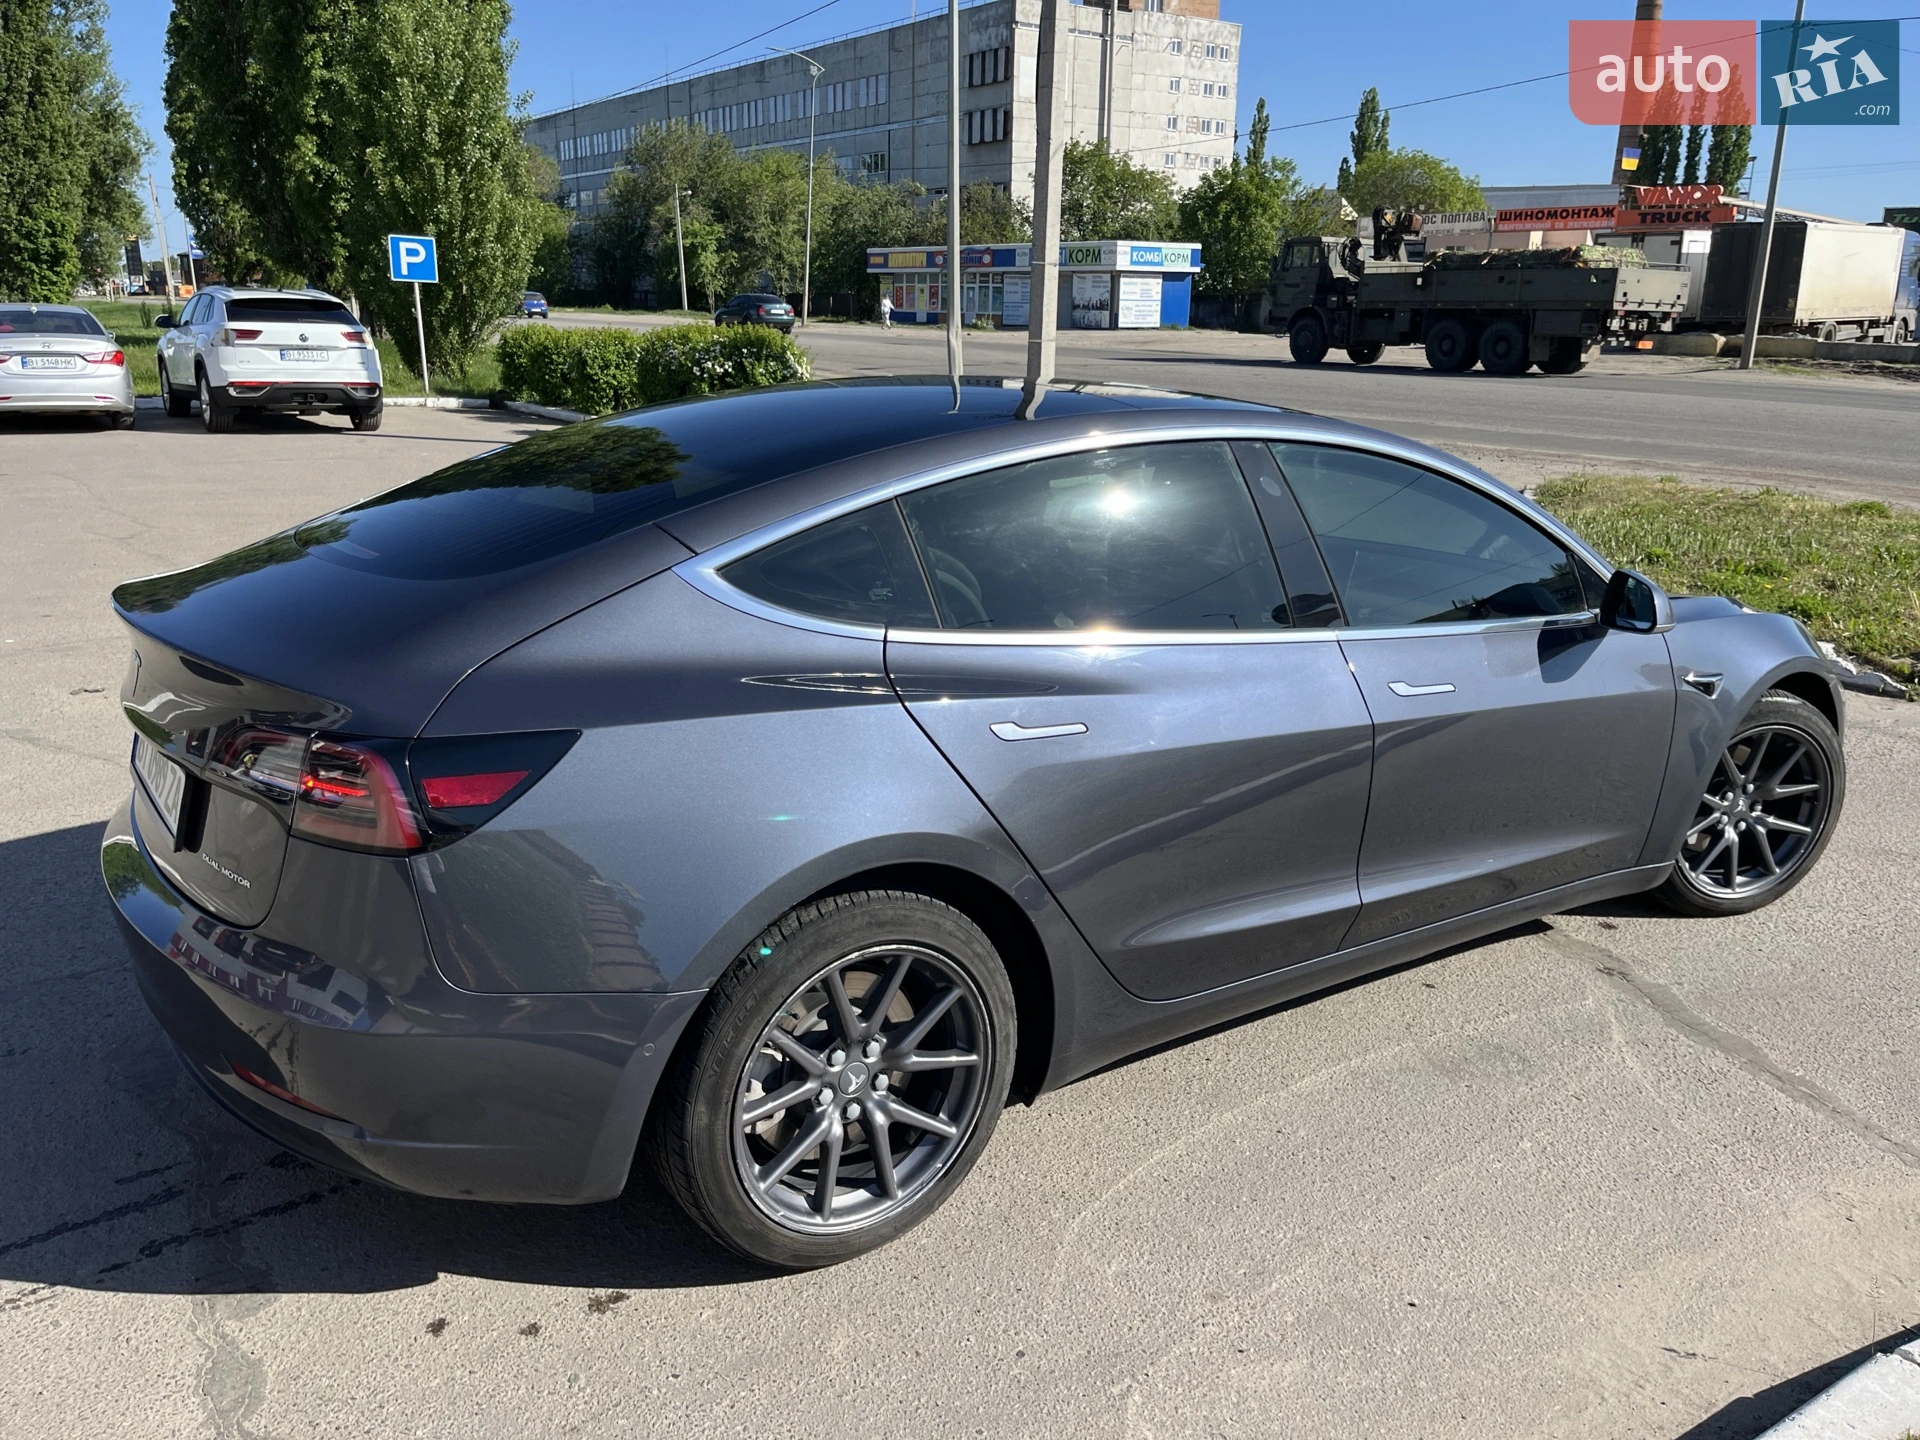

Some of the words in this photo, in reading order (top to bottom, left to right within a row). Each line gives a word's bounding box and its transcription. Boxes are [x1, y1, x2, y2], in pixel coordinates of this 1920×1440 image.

[1440, 212, 1485, 225] ПОЛТАВА
[1499, 207, 1616, 222] ШИНОМОНТАЖ
[1638, 210, 1711, 224] TRUCK
[1893, 213, 1920, 224] Tu
[399, 241, 427, 276] P
[1067, 248, 1101, 264] КОРМ
[1132, 251, 1162, 263] КОМБІ
[1164, 252, 1190, 263] КОРМ
[202, 853, 220, 871] DUAL
[222, 867, 251, 889] MOTOR
